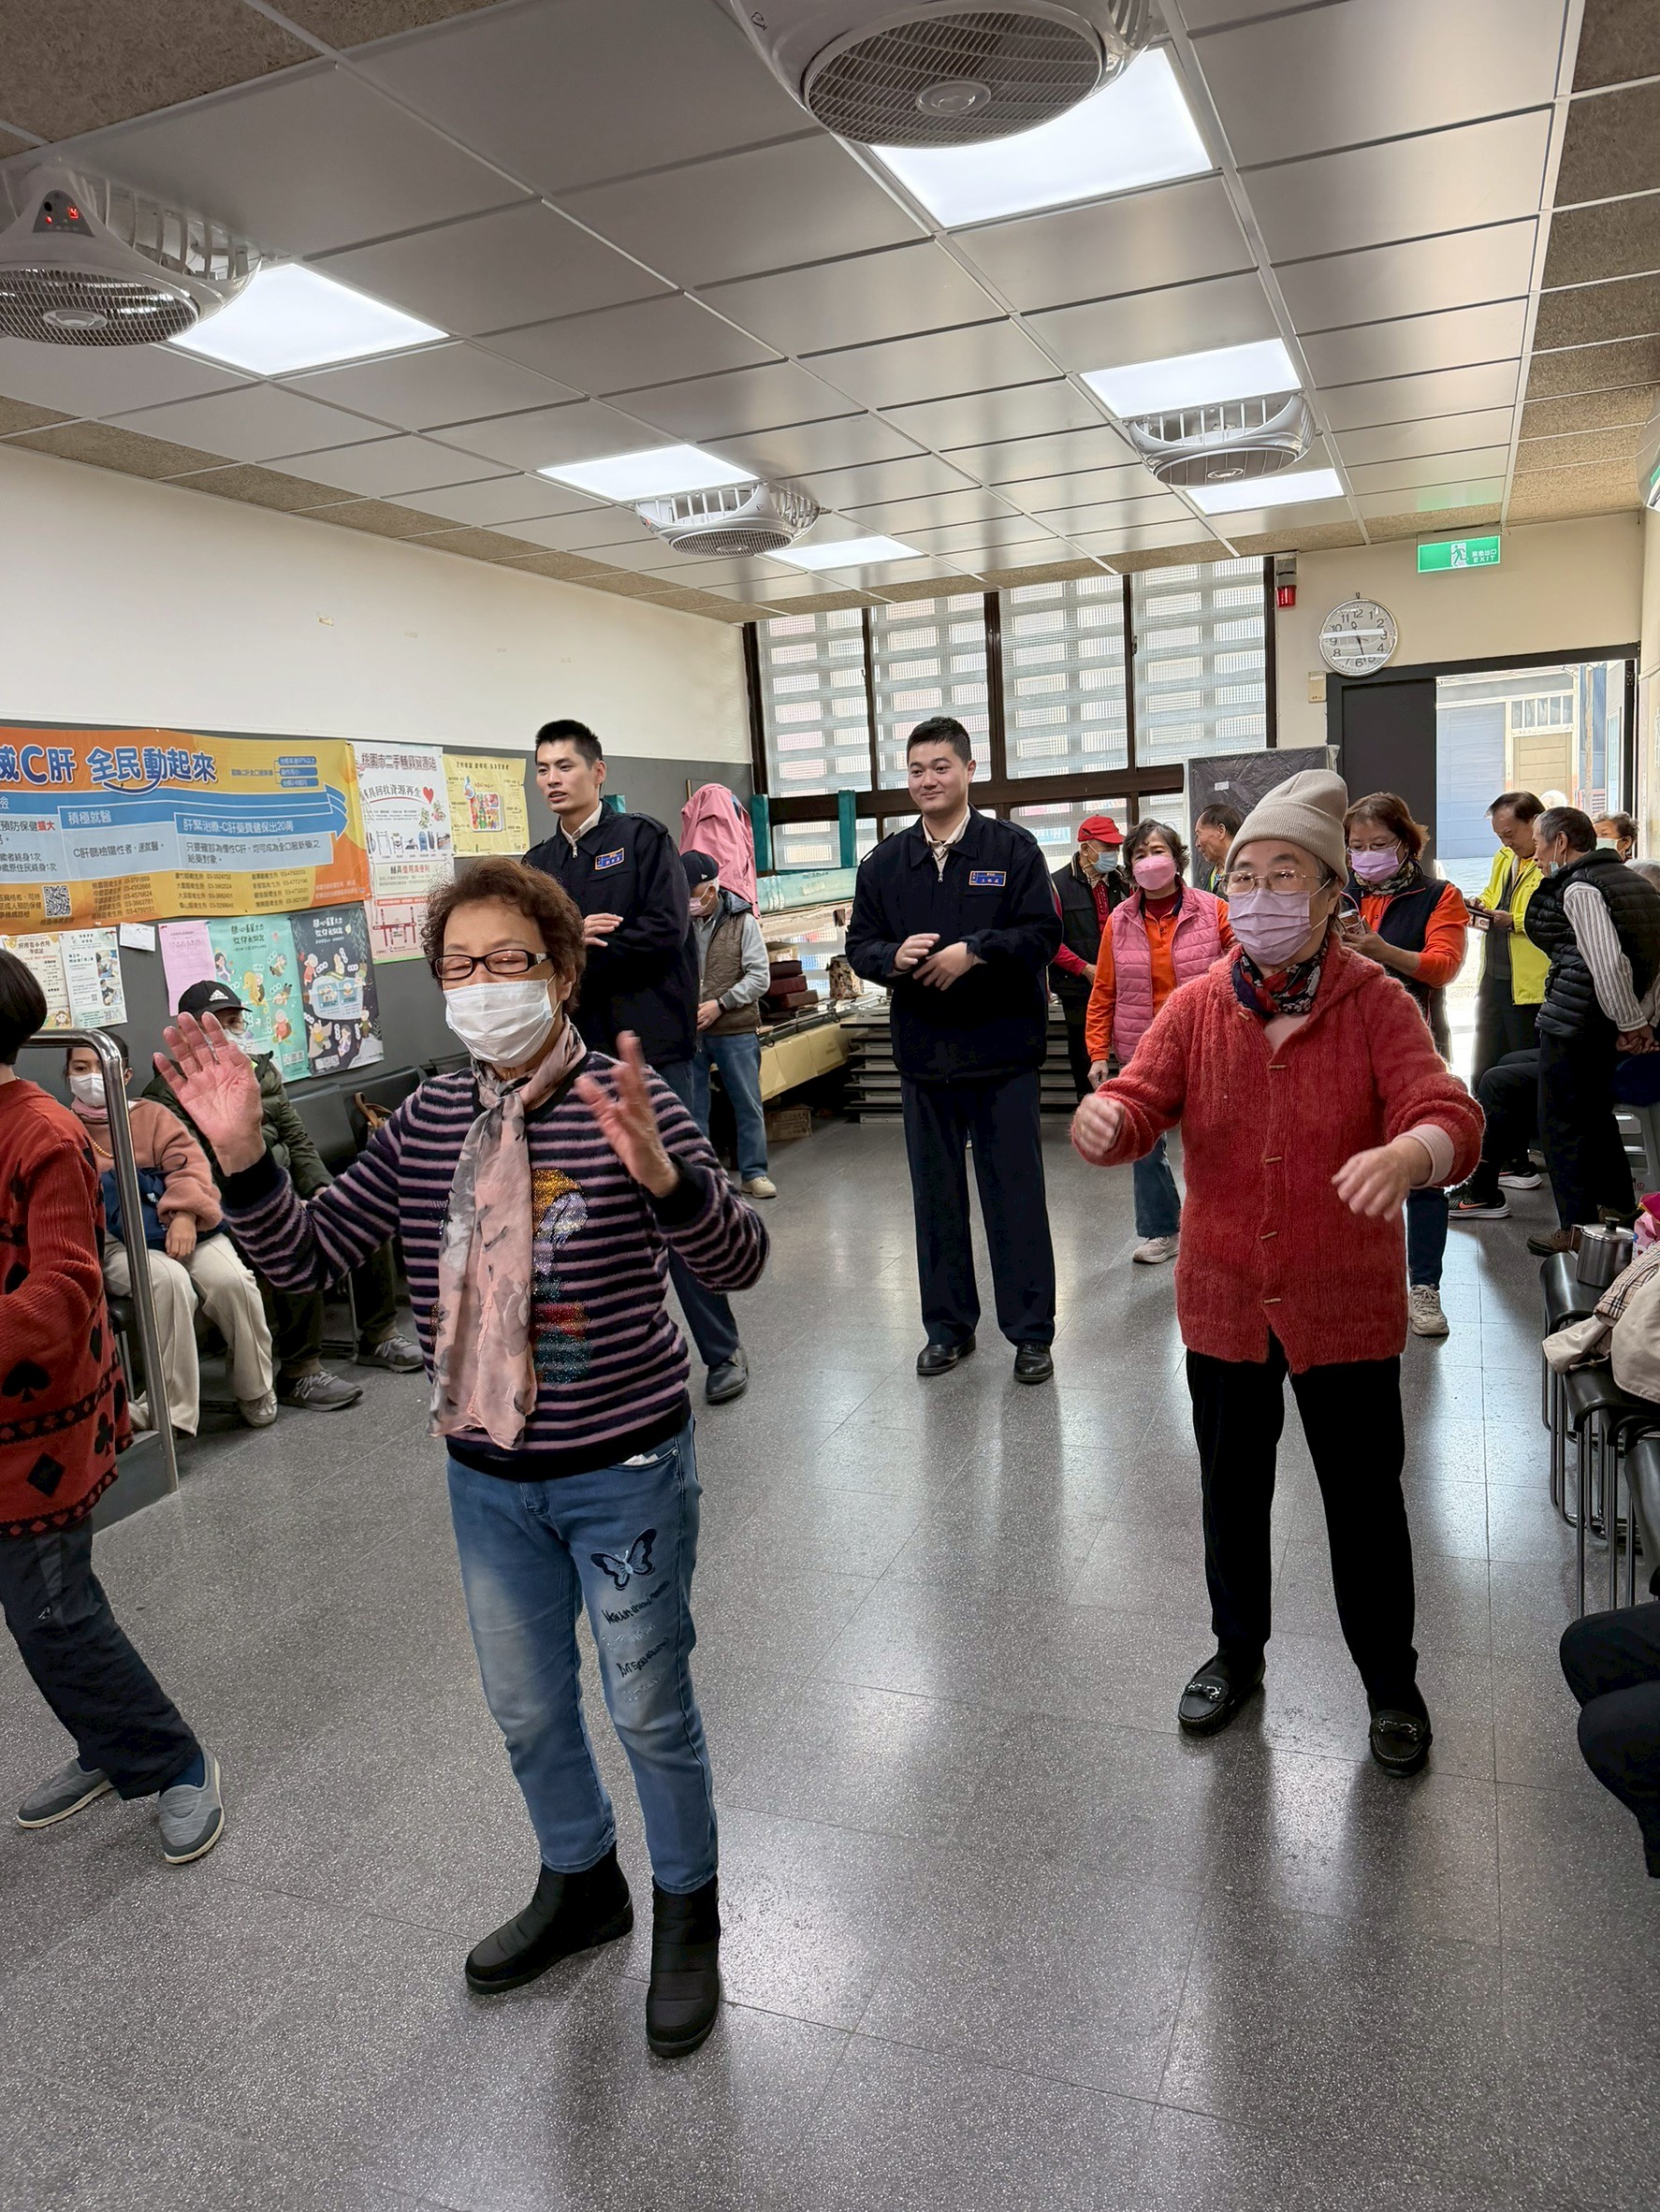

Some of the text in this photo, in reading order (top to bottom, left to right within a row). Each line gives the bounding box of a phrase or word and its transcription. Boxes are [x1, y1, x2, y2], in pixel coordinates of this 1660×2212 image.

[1472, 548, 1497, 558] 緊急出口
[1473, 555, 1495, 563] EXIT
[87, 747, 216, 792] 全民動起來
[68, 809, 111, 825] 積極就醫
[0, 821, 55, 832] 預防保健擴大
